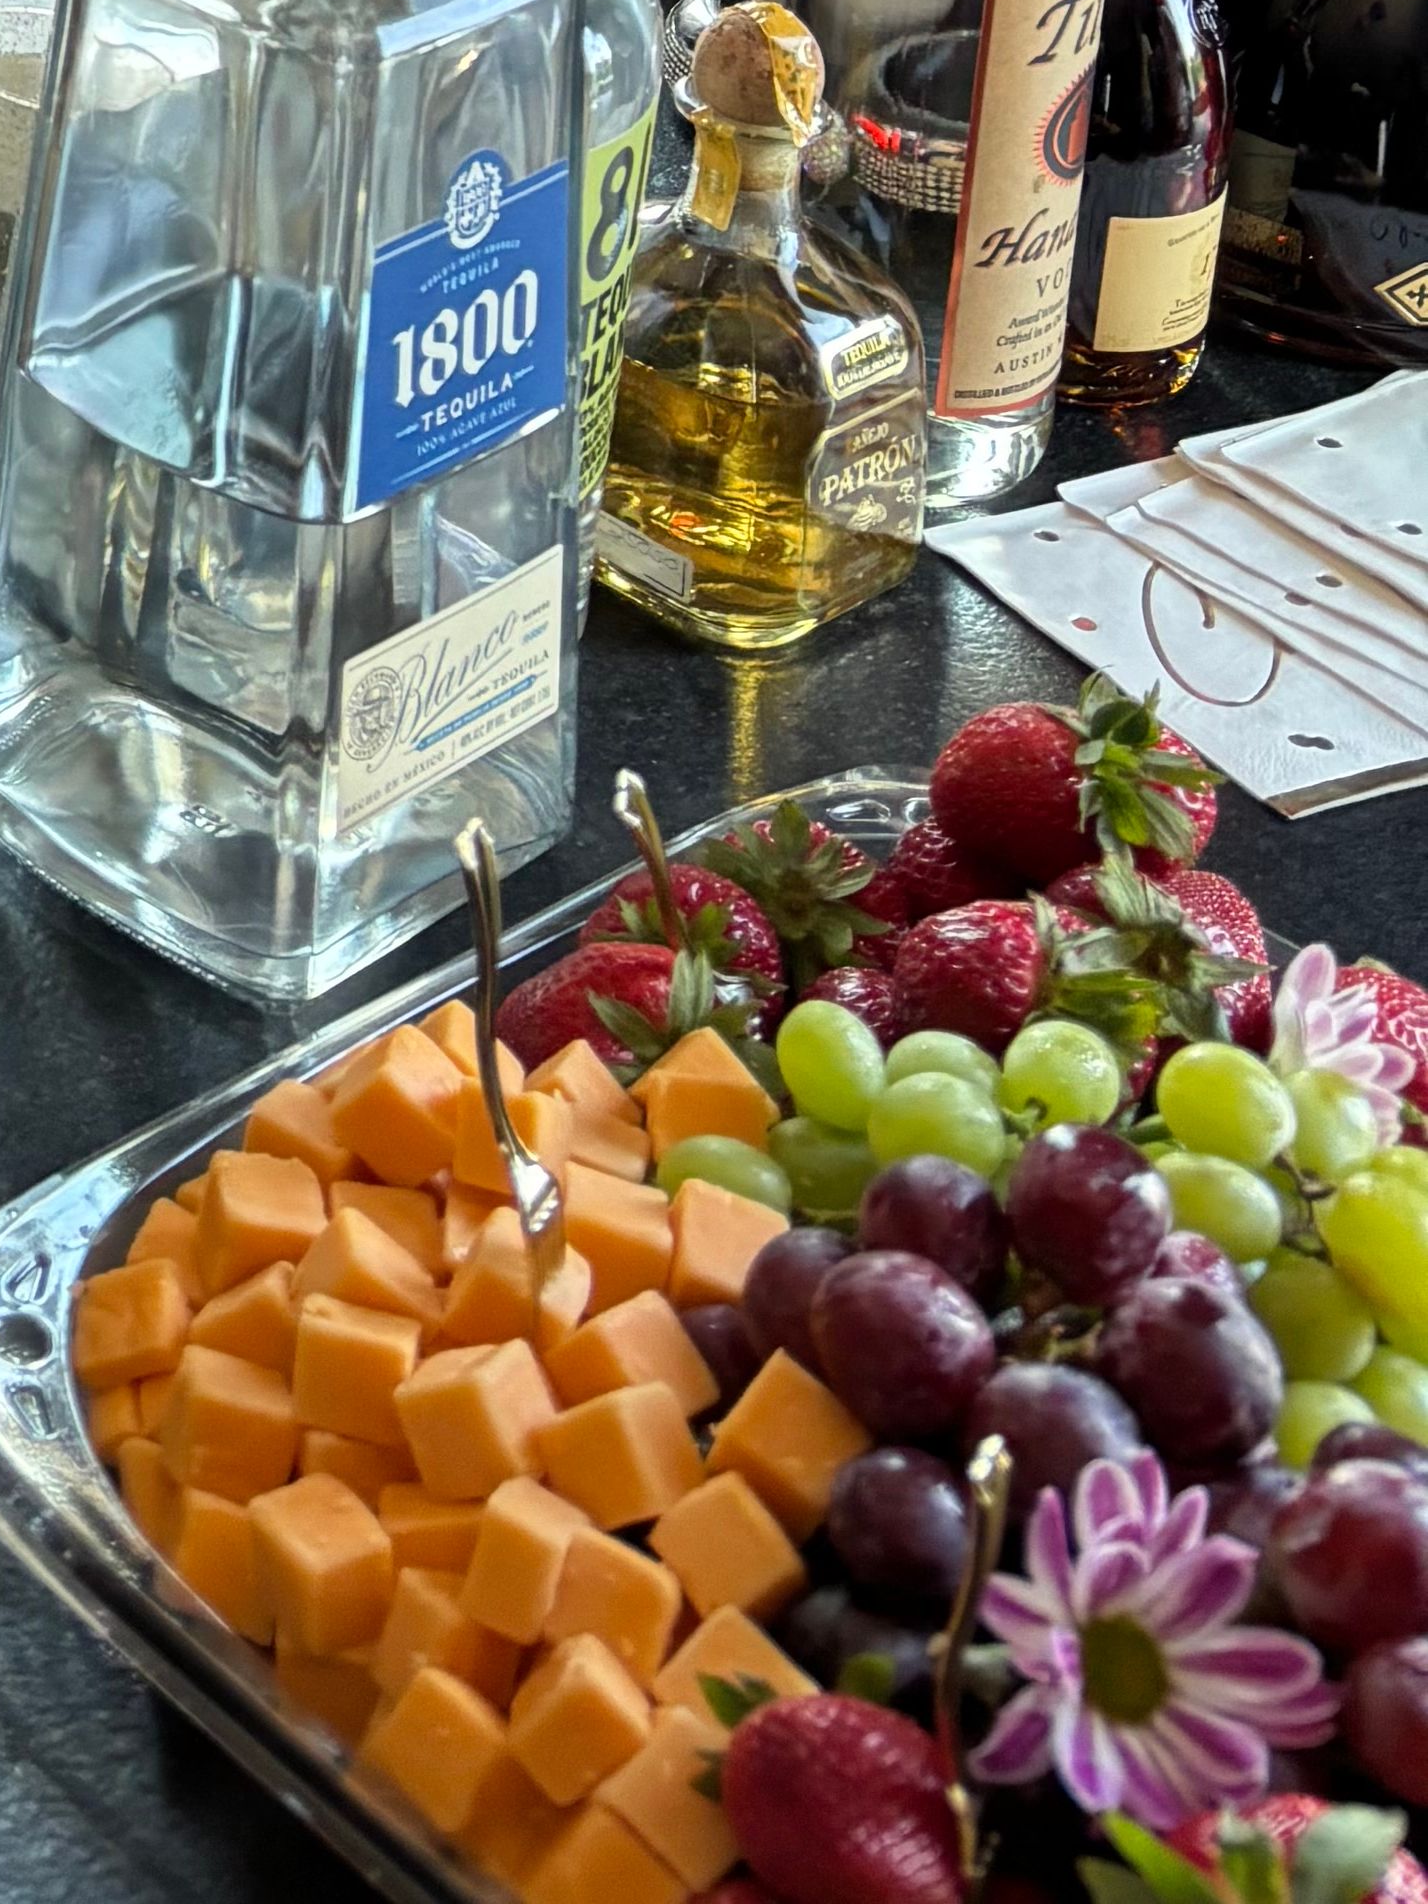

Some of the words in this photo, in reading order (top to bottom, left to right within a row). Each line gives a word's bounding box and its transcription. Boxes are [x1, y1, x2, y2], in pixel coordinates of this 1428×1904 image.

[442, 256, 500, 294] TEQUILA
[392, 269, 540, 409] 1800
[840, 331, 892, 367] TEQUILA
[994, 343, 1054, 375] AUSTIN
[420, 372, 514, 433] TEQUILA
[451, 411, 487, 440] AGAVE
[489, 396, 517, 419] AZUL
[851, 421, 890, 454] AÑEJO
[819, 432, 918, 508] PATRÓN
[367, 609, 520, 774] Blanco
[492, 648, 550, 692] TEQUILA
